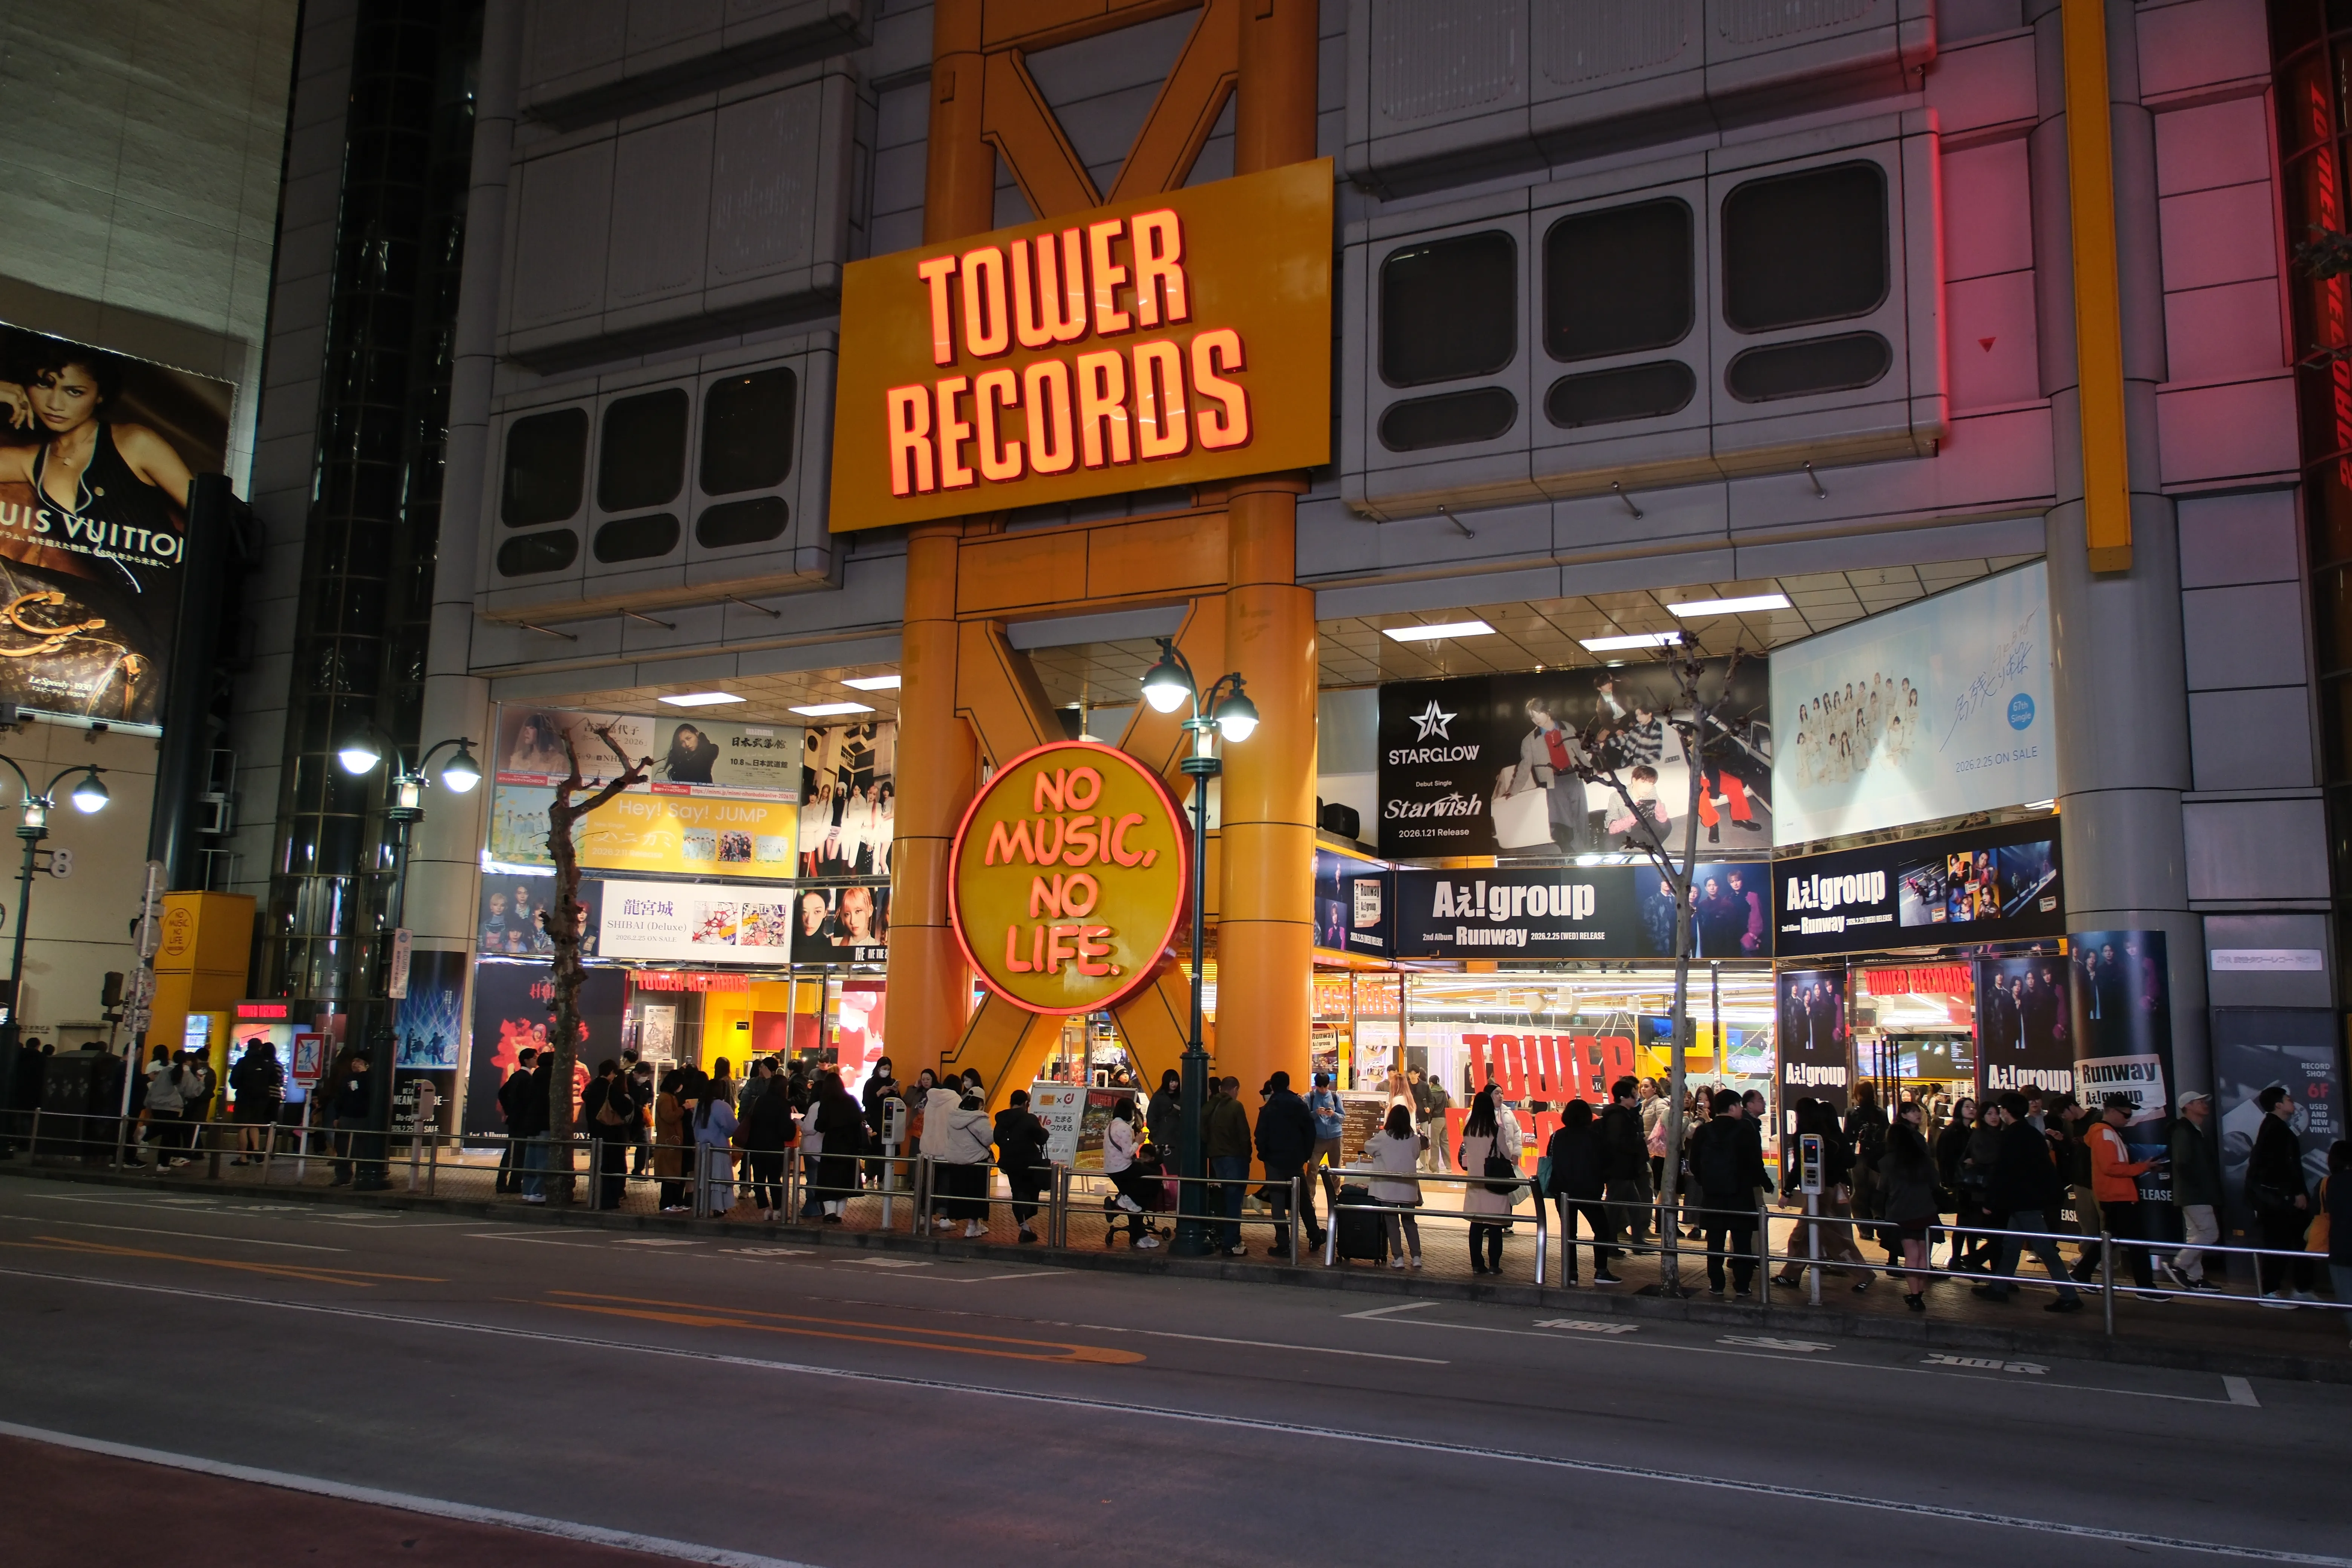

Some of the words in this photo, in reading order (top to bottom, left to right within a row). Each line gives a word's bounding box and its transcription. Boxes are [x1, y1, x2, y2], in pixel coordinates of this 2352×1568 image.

[919, 208, 1191, 366] TOWER
[887, 328, 1253, 498] RECORDS
[41, 677, 69, 689] Speedy
[2013, 701, 2029, 711] 67th
[2011, 711, 2031, 723] Single
[753, 759, 788, 769] 日本武道館
[1389, 745, 1480, 765] STARGLOW
[1955, 756, 1993, 773] 2026.2.25
[1995, 753, 2009, 765] ON
[2013, 746, 2038, 761] SALE
[1034, 767, 1101, 812] NO
[619, 799, 661, 821] Hey!
[668, 803, 709, 824] Say!
[716, 805, 767, 822] JUMP
[1384, 792, 1482, 819] Starwish
[985, 813, 1156, 867] MUSIC,
[1398, 829, 1436, 838] 2026.1.21
[592, 847, 627, 857] 2026.2.11
[629, 848, 663, 859] Release
[1029, 873, 1098, 918] NO
[1361, 883, 1379, 898] Runway
[1433, 880, 1595, 921] Aぇ!group
[1787, 870, 1885, 911] Aぇ!group
[623, 899, 674, 917] 龍宮城
[696, 901, 738, 911] SHIBAI
[743, 903, 786, 915] SHIBAI
[607, 920, 645, 929] SHIBAI
[647, 921, 687, 933] (Deluxe)
[1801, 916, 1845, 934] Runway
[1456, 926, 1528, 947] Runway
[1560, 932, 1579, 940] [WED]
[1579, 932, 1605, 940] RELEASE
[876, 949, 884, 959] THE
[1006, 925, 1120, 975] LIFE.
[638, 971, 684, 991] TOWER
[687, 973, 748, 993] RECORDS
[1865, 972, 1909, 995] TOWER
[1910, 966, 1971, 994] RECORDS
[259, 1004, 287, 1018] RECORDS
[1462, 1034, 1636, 1104] TOWER
[2082, 1062, 2155, 1084] Runway
[1088, 1093, 1112, 1107] TOWER
[2307, 1083, 2329, 1098] 6F
